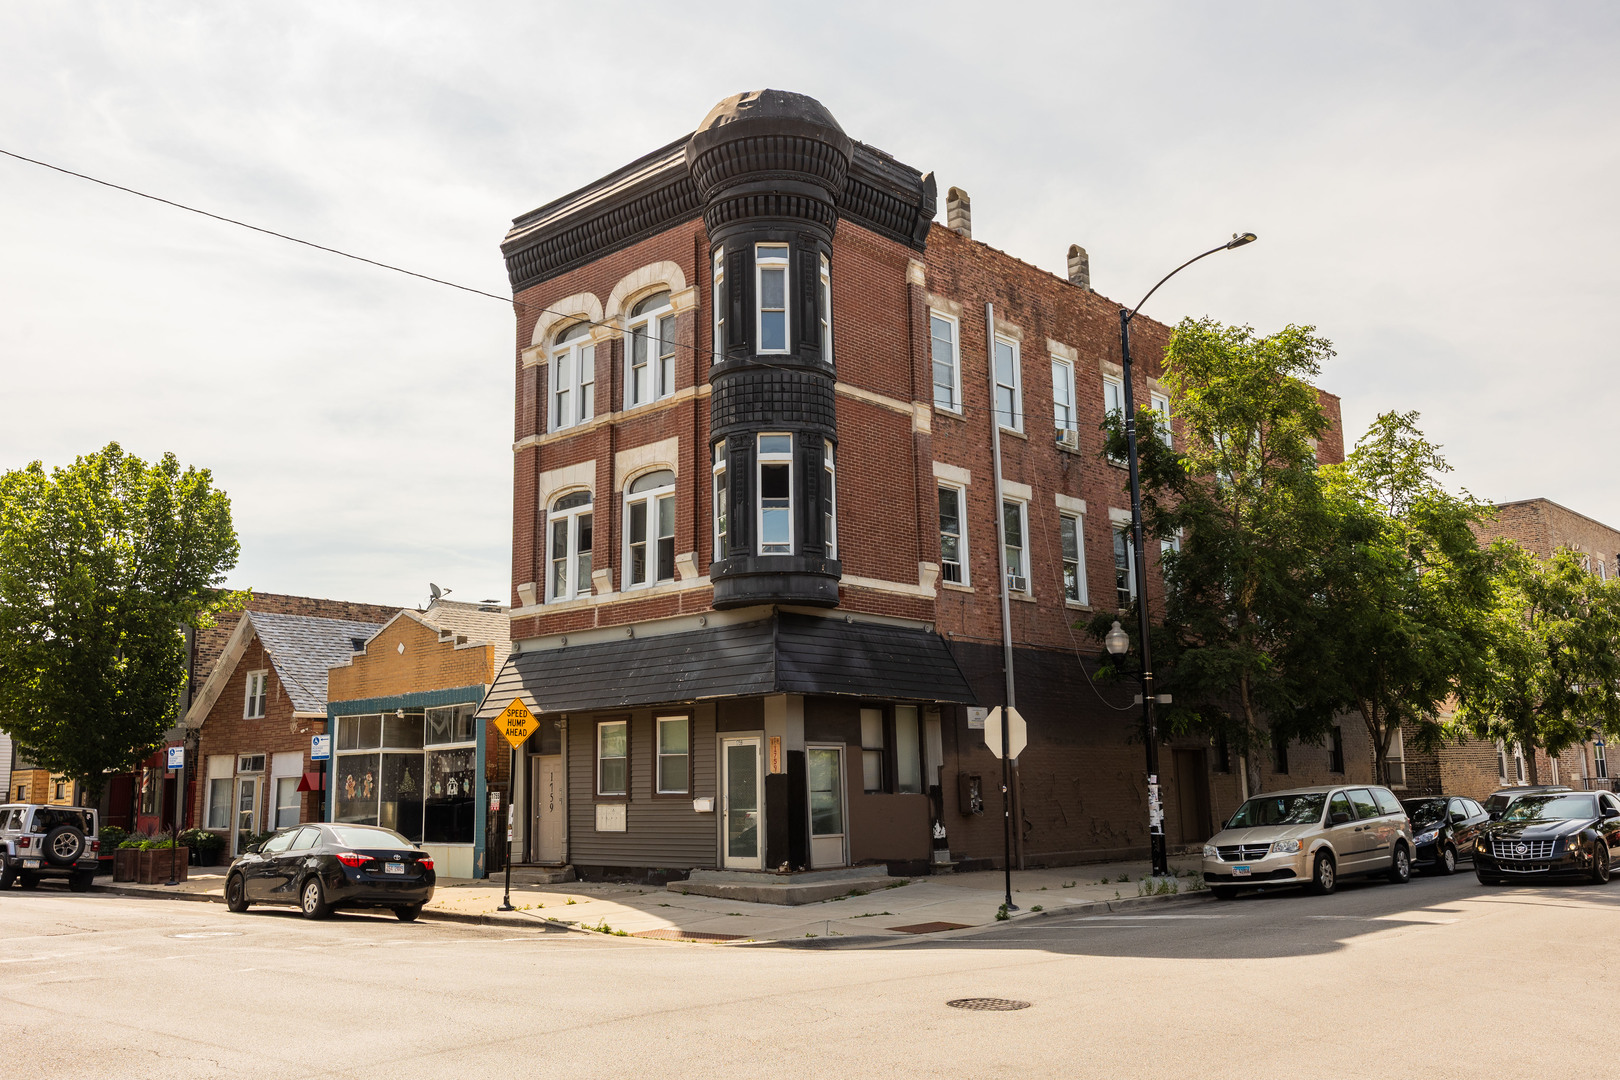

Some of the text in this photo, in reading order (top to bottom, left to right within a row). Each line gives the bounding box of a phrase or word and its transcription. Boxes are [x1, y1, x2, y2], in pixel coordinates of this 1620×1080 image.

[506, 709, 528, 718] SPEED
[507, 718, 526, 727] HUMP
[505, 728, 527, 737] AHEAD
